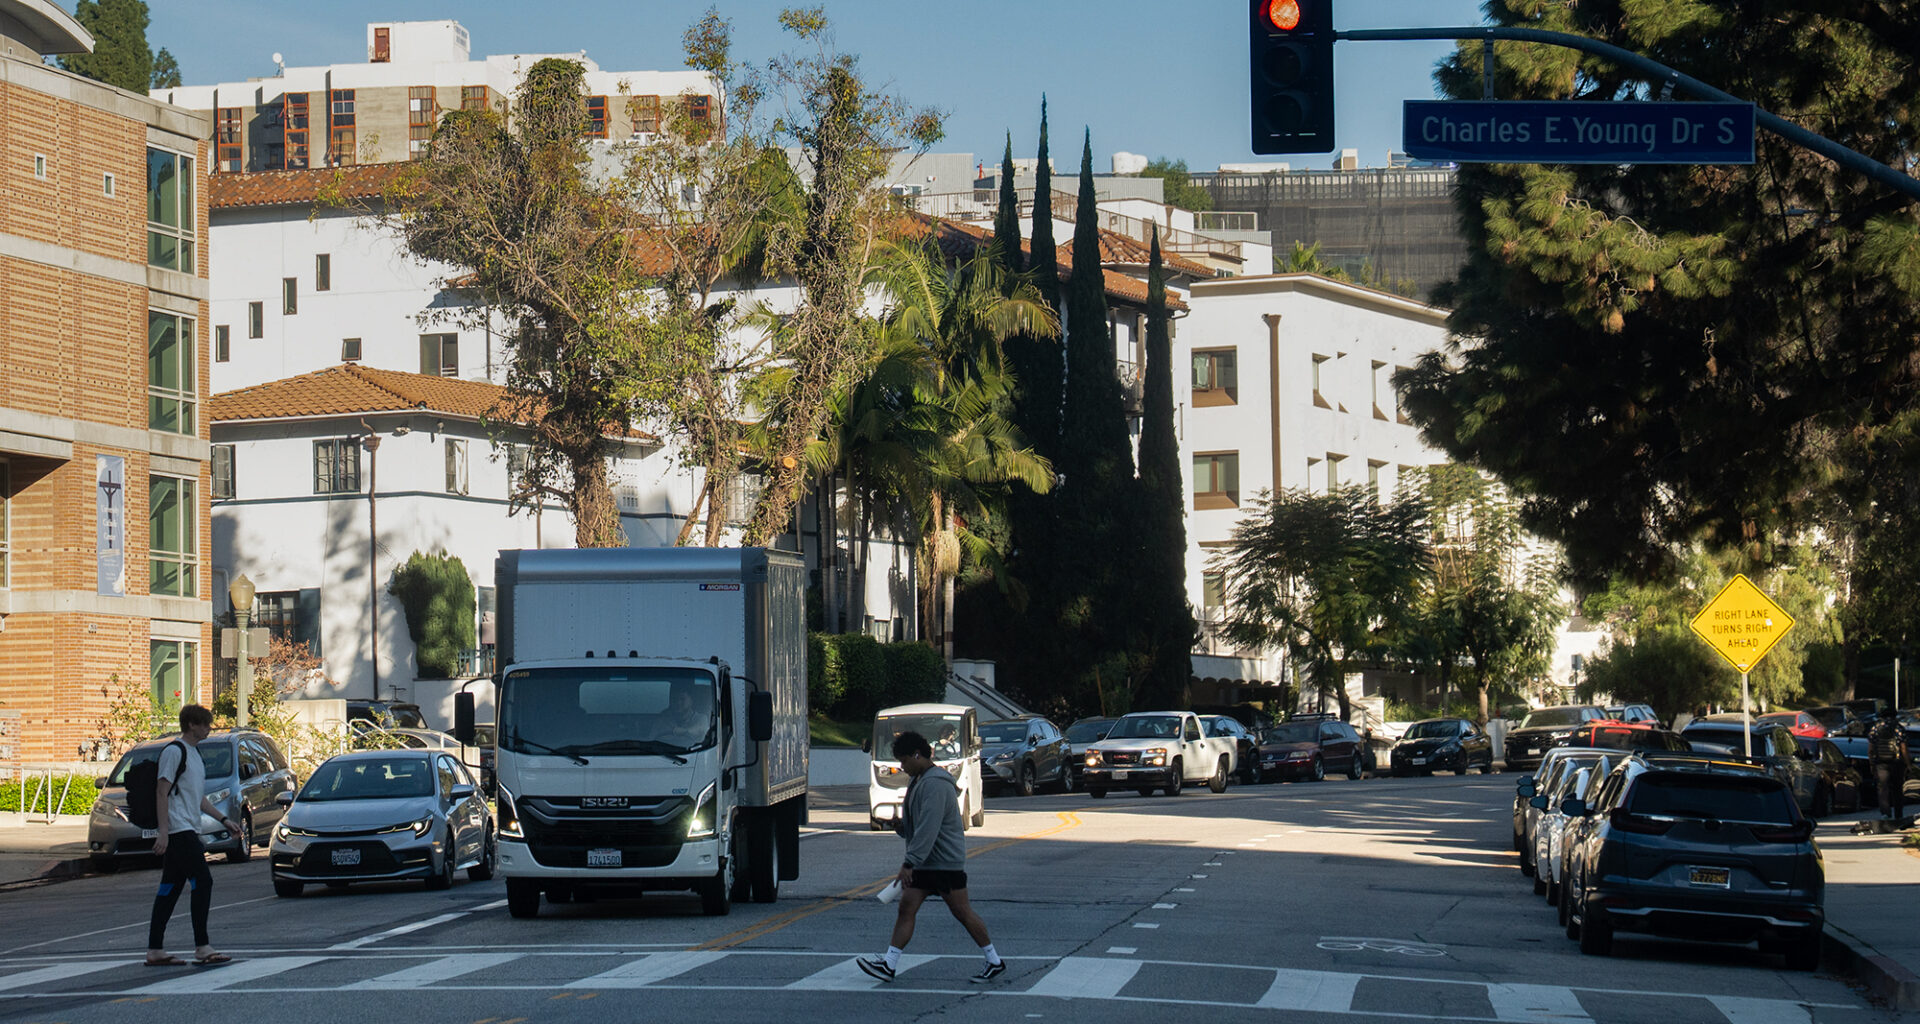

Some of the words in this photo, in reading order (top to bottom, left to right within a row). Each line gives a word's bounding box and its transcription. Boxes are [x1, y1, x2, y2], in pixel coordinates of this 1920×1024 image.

[1422, 115, 1531, 143] Charles
[1671, 117, 1705, 144] Dr
[1716, 117, 1736, 144] S
[1714, 609, 1742, 620] RIGHT
[1745, 608, 1769, 619] LANE
[1712, 624, 1743, 634] TURNS
[1745, 622, 1773, 634] RIGHT
[1727, 638, 1759, 648] AHEAD
[582, 797, 629, 807] ISUZU
